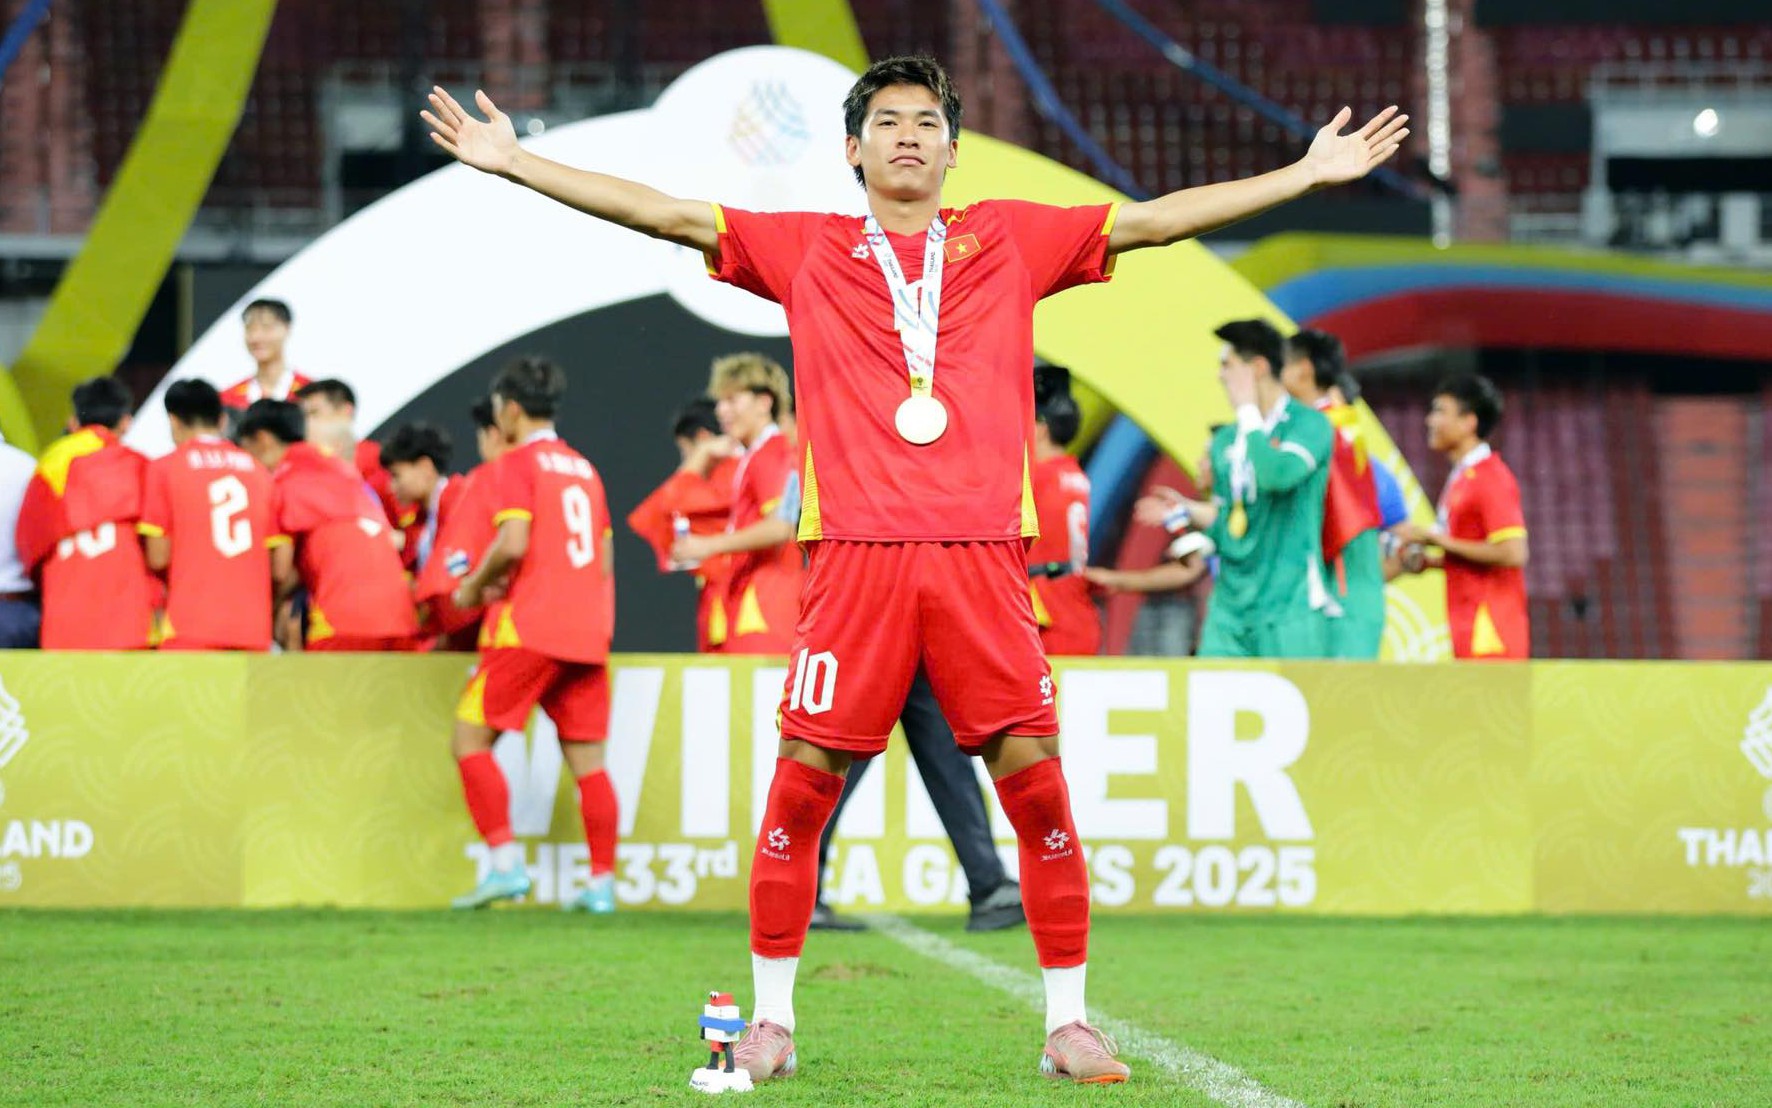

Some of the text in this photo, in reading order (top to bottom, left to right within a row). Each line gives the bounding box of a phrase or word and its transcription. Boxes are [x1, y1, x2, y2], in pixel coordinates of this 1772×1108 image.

[208, 474, 253, 559] 2
[561, 484, 595, 570] 9
[789, 647, 839, 716] 10
[468, 666, 1316, 840] WIER
[0, 818, 95, 859] AND
[614, 842, 738, 905] 33rd
[1152, 844, 1317, 907] 2025
